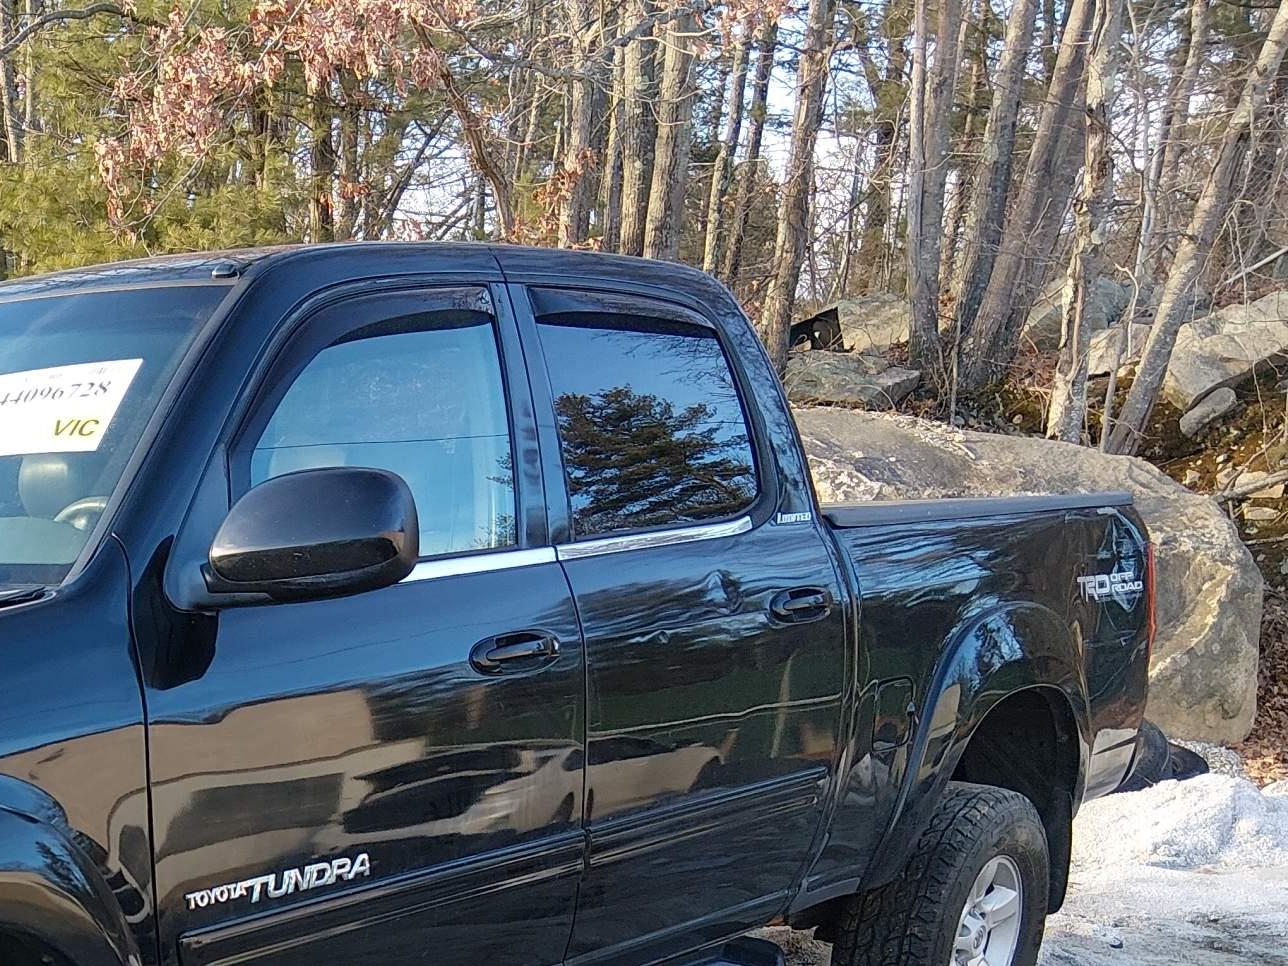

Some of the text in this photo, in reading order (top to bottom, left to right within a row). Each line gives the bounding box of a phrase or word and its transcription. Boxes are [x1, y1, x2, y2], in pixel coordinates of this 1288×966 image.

[53, 418, 100, 437] VIC
[1110, 571, 1134, 582] OFF
[1076, 574, 1111, 602] TRD
[1112, 580, 1144, 593] ROAD
[185, 852, 371, 910] TOYOTA TUNDRA
